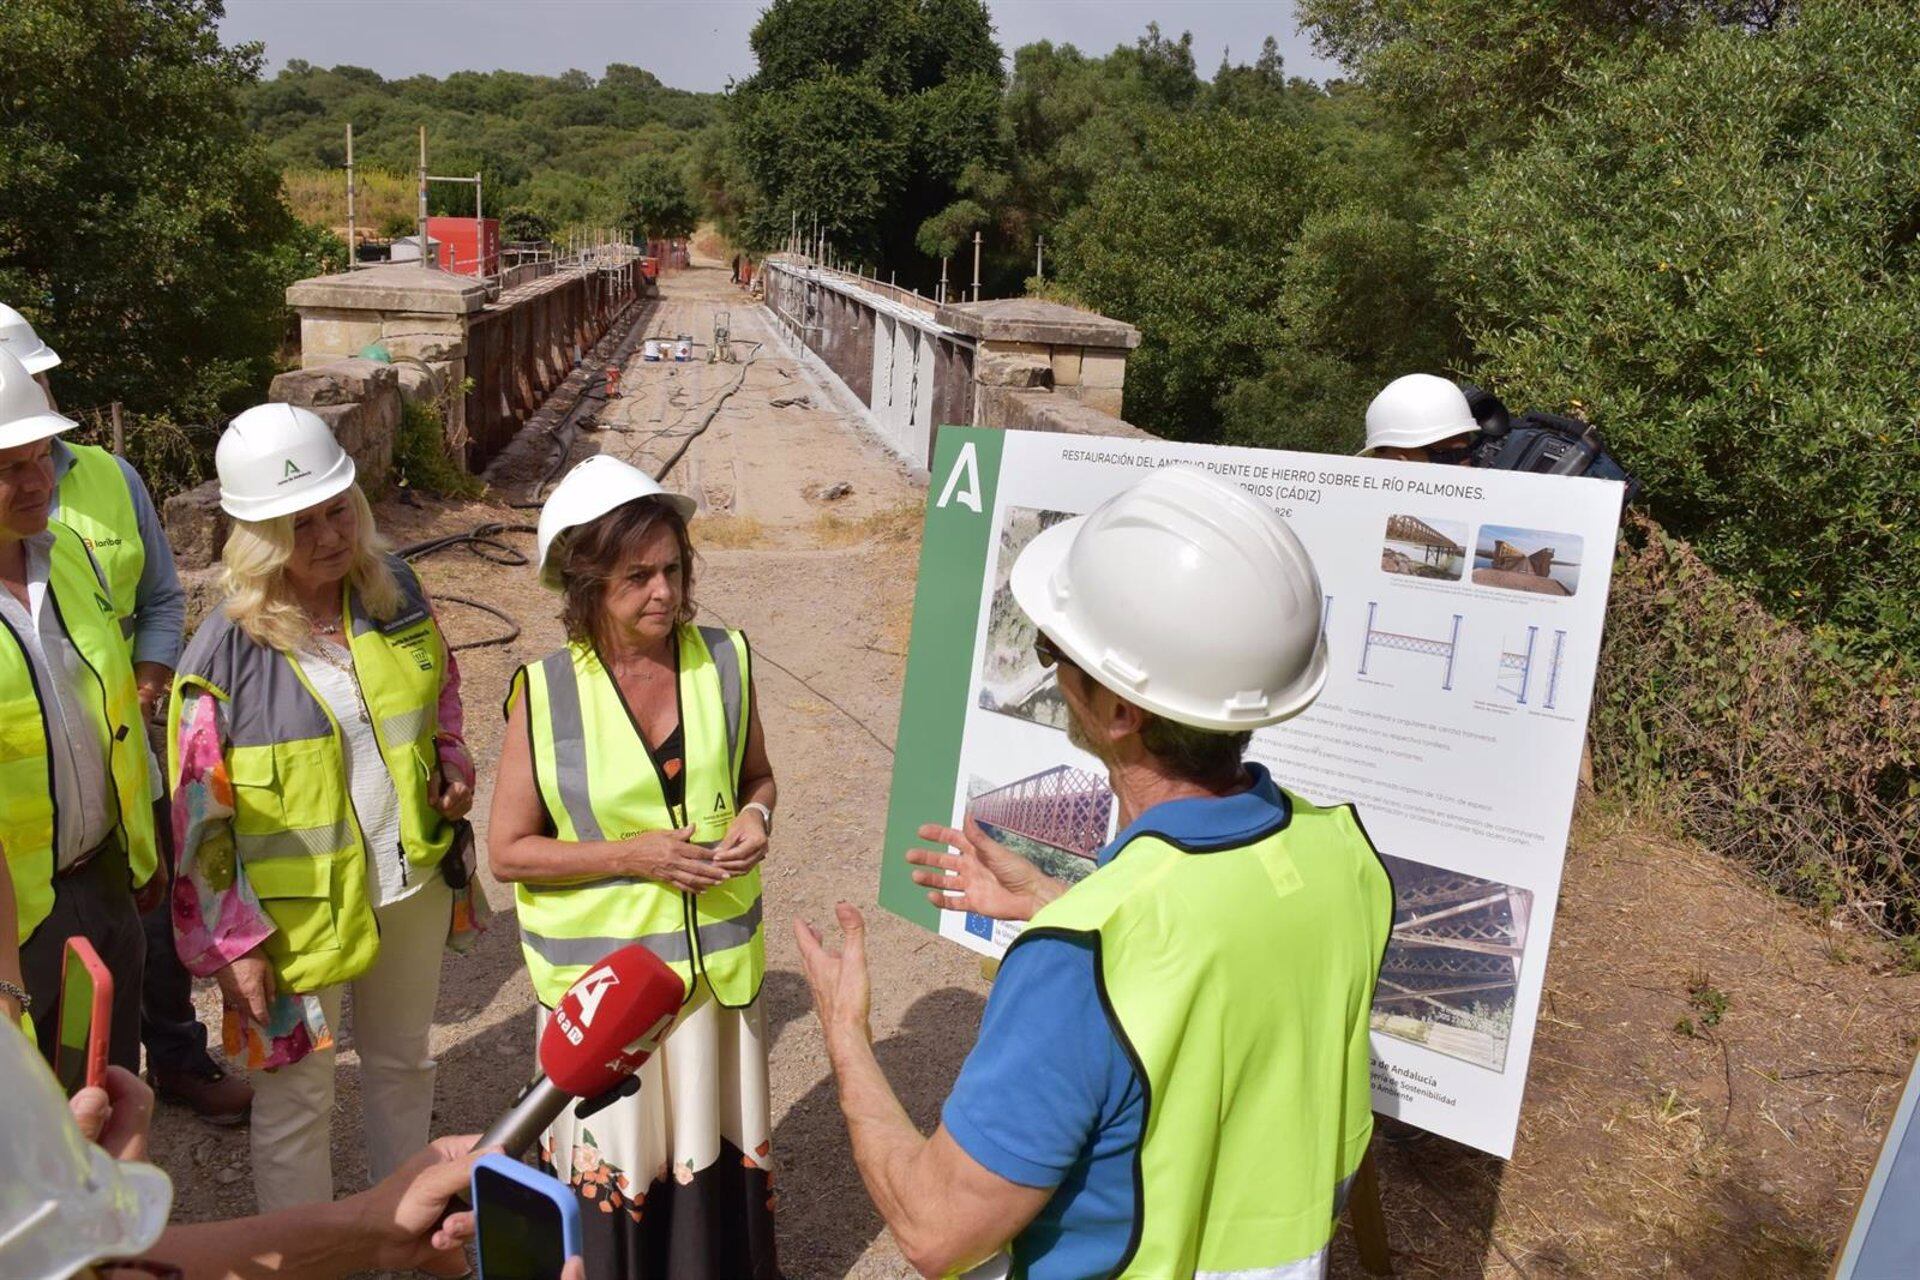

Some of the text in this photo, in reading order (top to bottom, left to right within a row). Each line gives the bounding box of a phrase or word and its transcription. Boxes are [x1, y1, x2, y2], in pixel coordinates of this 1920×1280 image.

[1062, 449, 1134, 466] RESTAURACIÓN
[1136, 456, 1155, 469] DEL
[1207, 462, 1251, 477] PUENTE
[1253, 466, 1269, 479] DE
[1271, 468, 1316, 483] HIERRO
[1318, 472, 1360, 488] SOBRE
[1363, 476, 1378, 490] EL
[1382, 476, 1404, 492] RÍO
[1406, 480, 1486, 500] PALMONES.
[1275, 484, 1321, 505] (CÁDIZ)
[1391, 1065, 1437, 1087] Andalucía
[1377, 1084, 1414, 1103] Ambiente
[1400, 1081, 1457, 1107] Sostenibilidad
